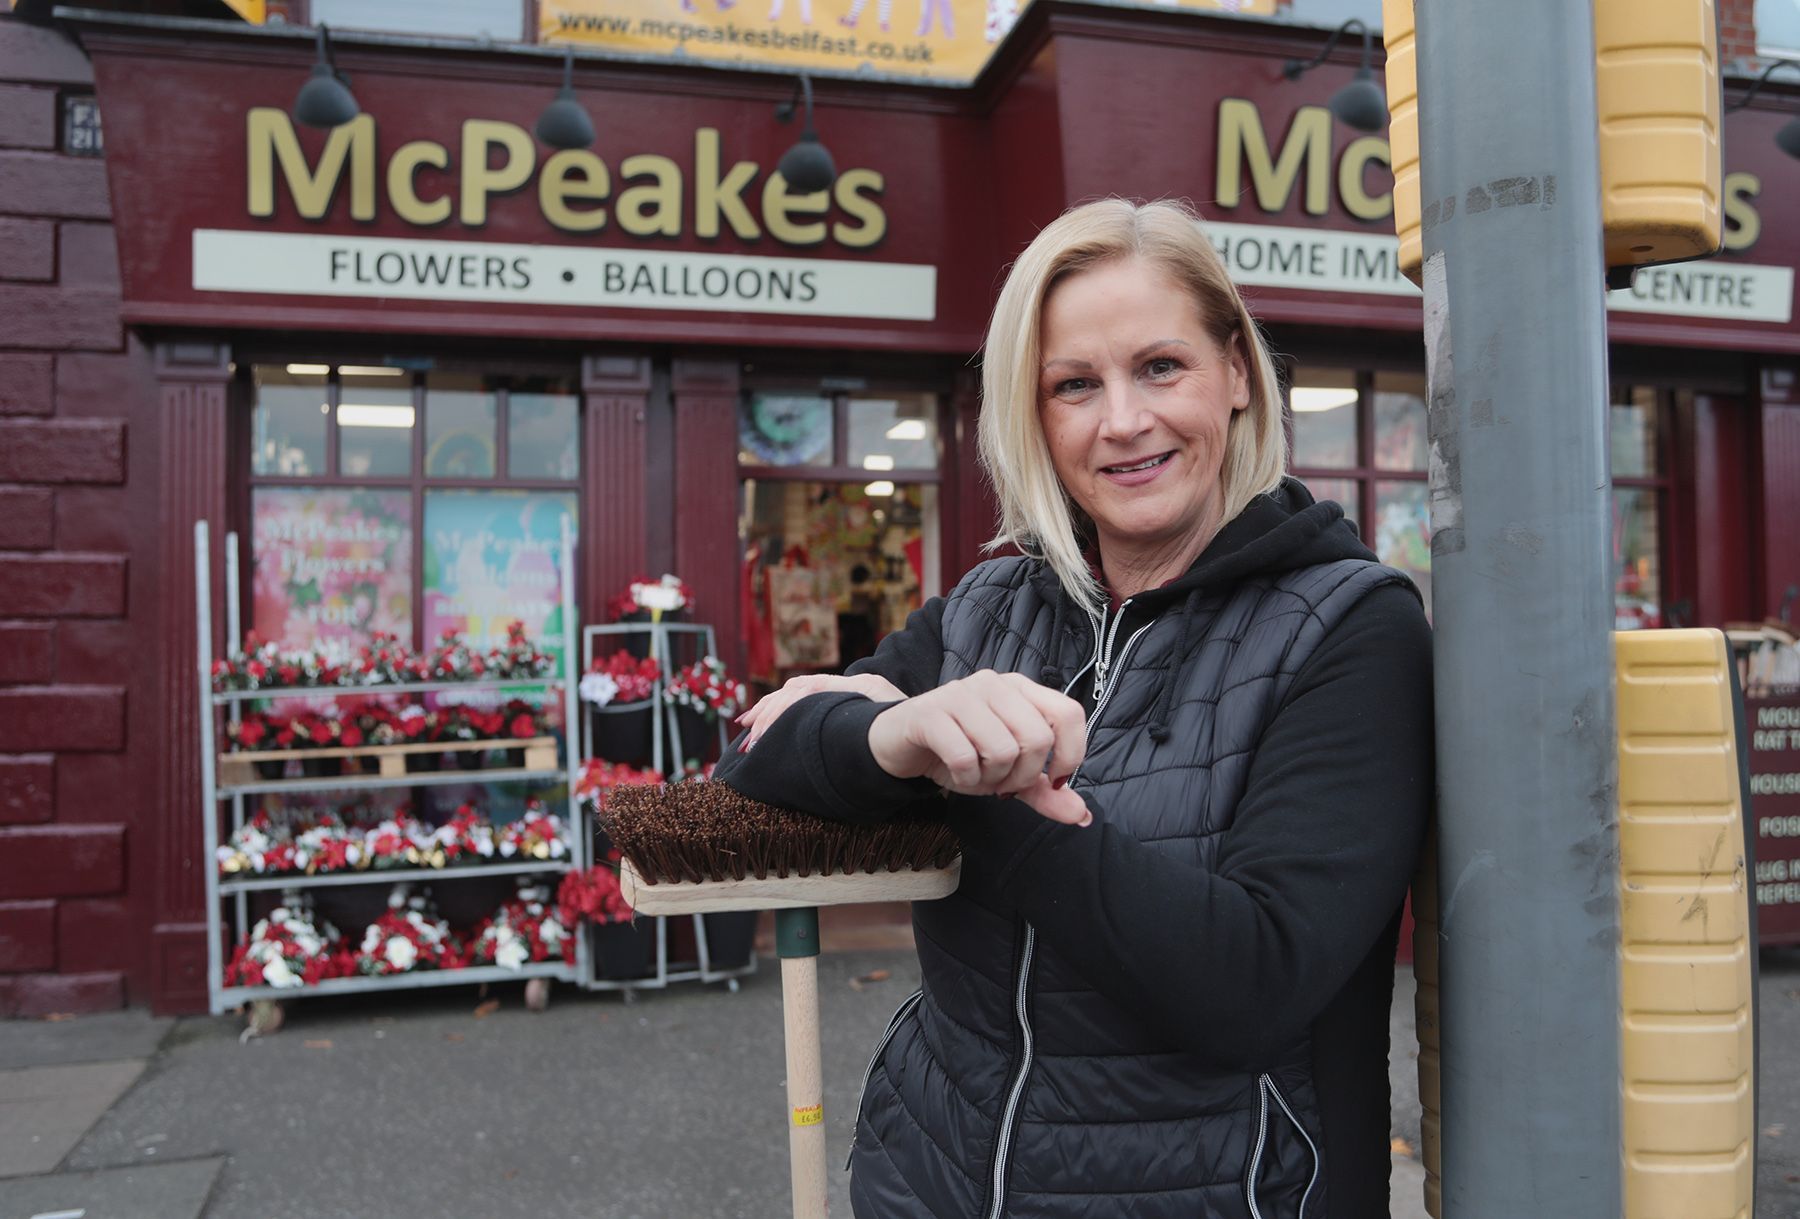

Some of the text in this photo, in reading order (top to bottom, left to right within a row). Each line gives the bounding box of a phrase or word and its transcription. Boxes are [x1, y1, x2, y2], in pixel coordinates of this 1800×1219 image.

[558, 11, 933, 63] www.mcpeakesbelfast.co.uk
[247, 107, 887, 248] McPeakes
[330, 249, 818, 302] FLOWERS BALLOONS
[1209, 237, 1326, 277] HOME
[1631, 269, 1756, 308] CENTRE
[1753, 729, 1788, 751] RAT
[1759, 815, 1800, 838] POIS
[1755, 860, 1788, 882] LUG
